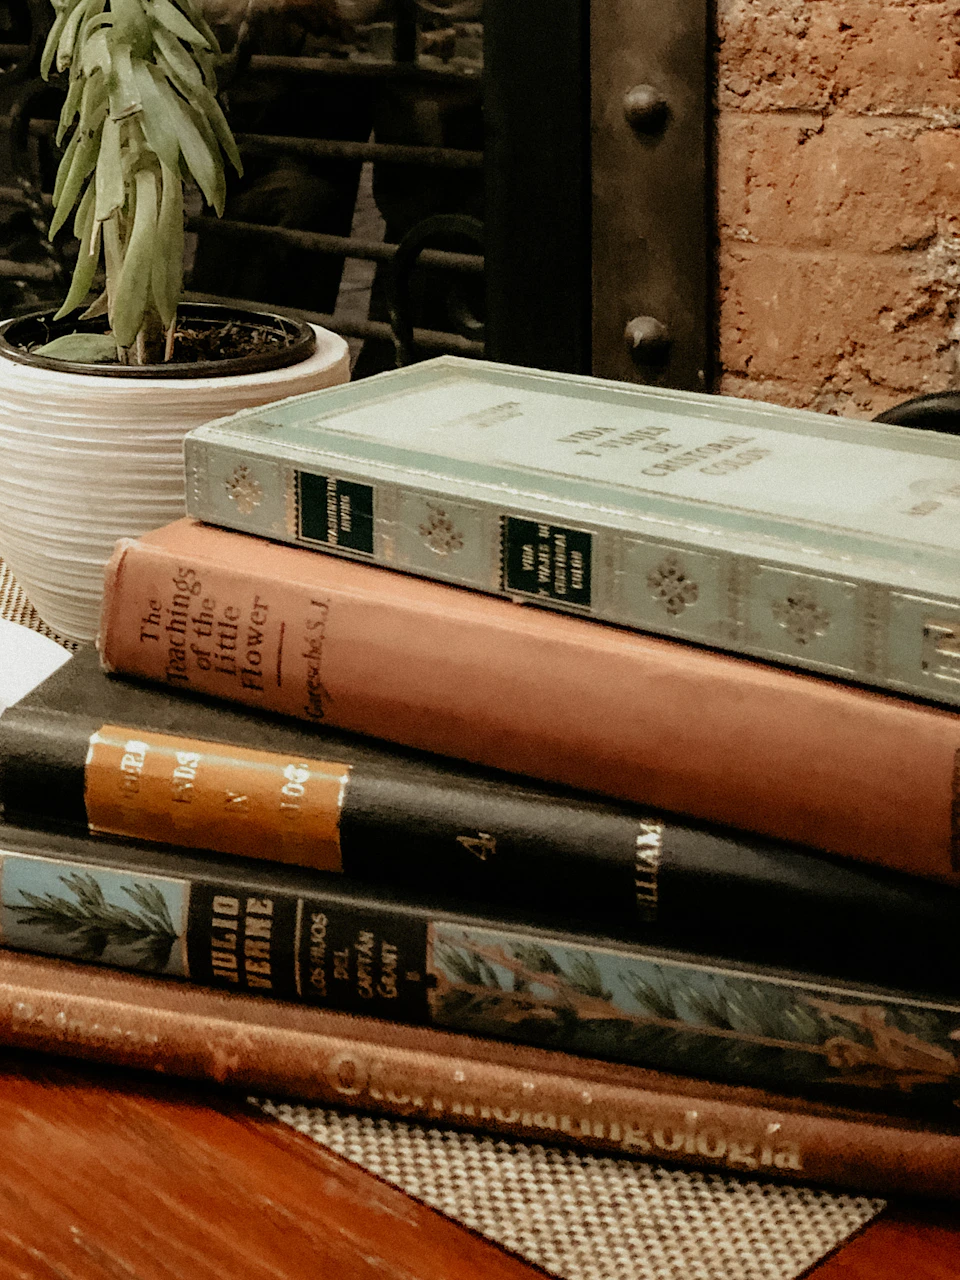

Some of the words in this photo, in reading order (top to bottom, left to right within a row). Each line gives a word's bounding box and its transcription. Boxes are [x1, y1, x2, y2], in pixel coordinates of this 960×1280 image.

[140, 599, 162, 642] The
[165, 567, 202, 681] Teachings
[191, 599, 216, 639] the
[214, 606, 240, 677] Little
[241, 595, 269, 693] Flower
[189, 643, 212, 672] of
[210, 895, 239, 984] JULIO
[244, 897, 274, 989] VERNE
[309, 913, 328, 965] HIJOS
[333, 948, 349, 981] DEL
[309, 967, 327, 998] LOS
[377, 940, 399, 999] GRANT
